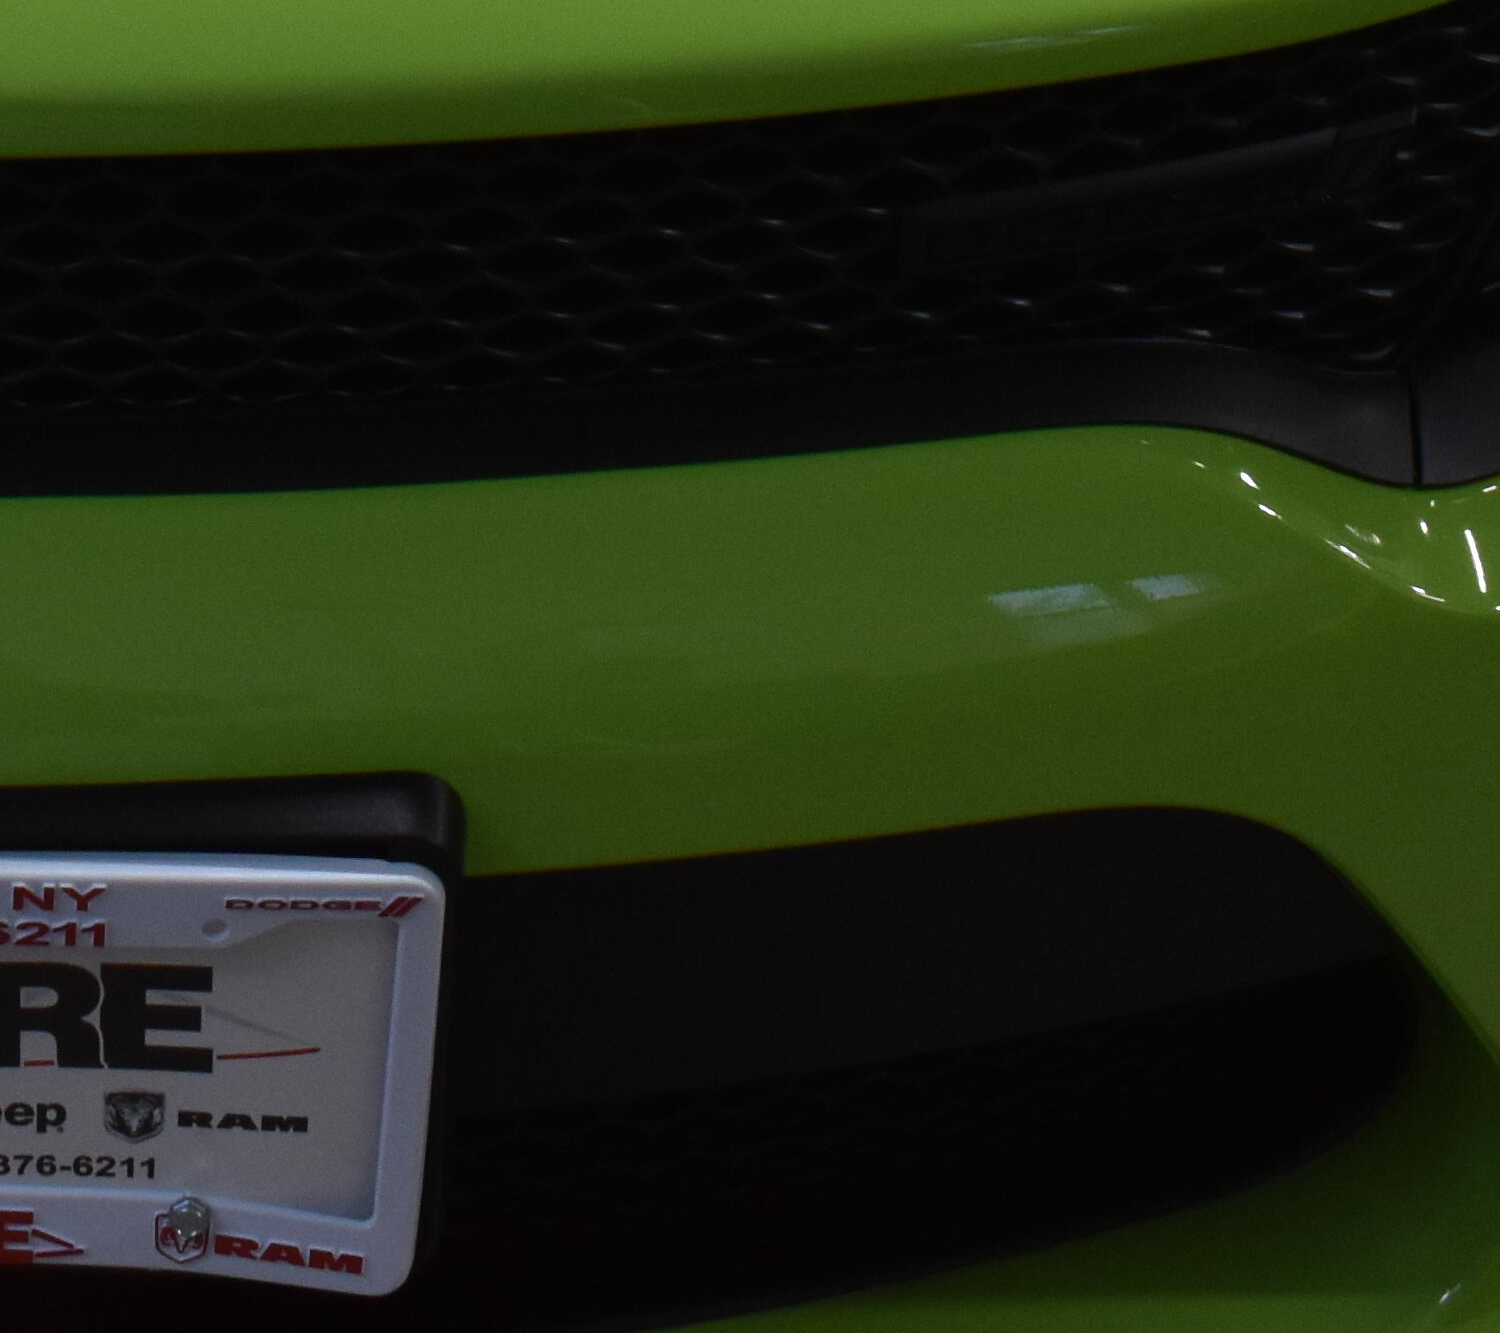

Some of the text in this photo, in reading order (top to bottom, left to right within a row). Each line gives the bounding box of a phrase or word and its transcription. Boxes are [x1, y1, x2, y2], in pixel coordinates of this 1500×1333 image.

[12, 883, 107, 912] NY
[225, 899, 383, 911] DODGE
[177, 1109, 310, 1133] RAM
[214, 1235, 364, 1275] RAM
